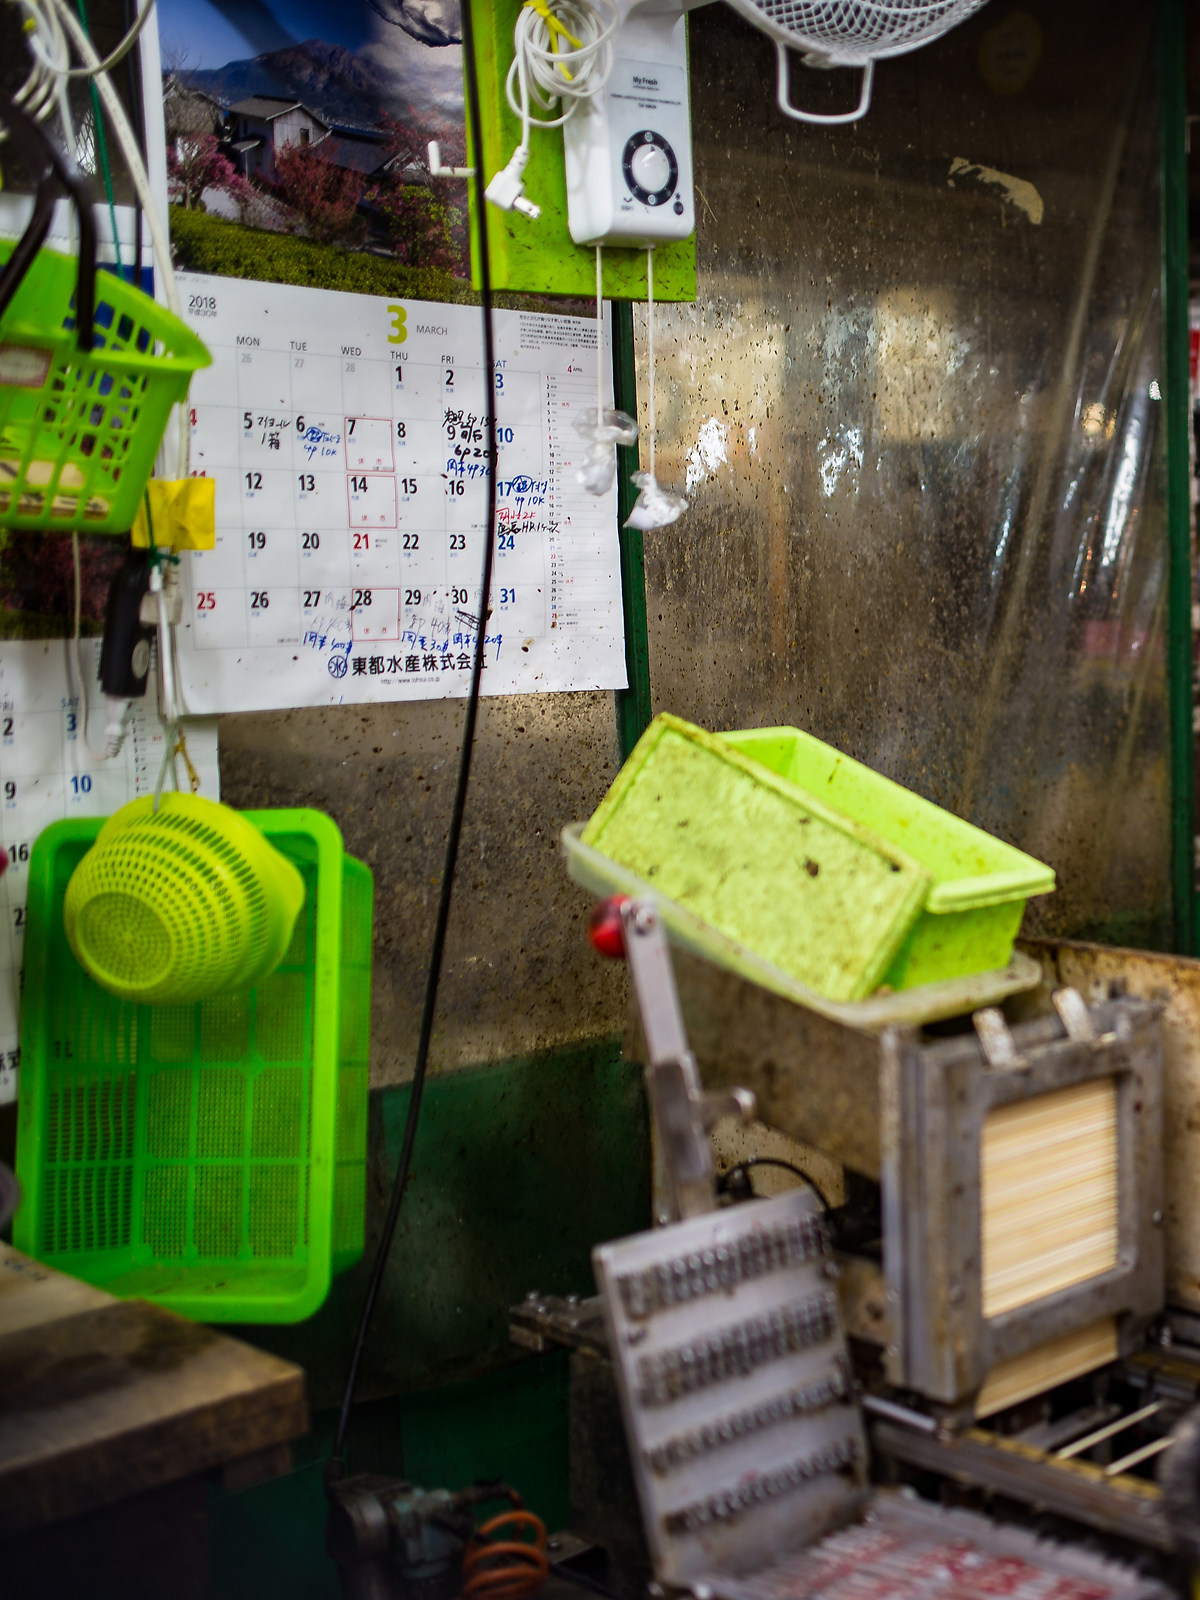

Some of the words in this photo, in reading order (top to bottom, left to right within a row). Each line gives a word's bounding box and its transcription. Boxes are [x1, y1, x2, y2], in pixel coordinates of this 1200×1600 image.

[633, 76, 642, 84] My
[642, 77, 658, 86] Fresh
[188, 294, 216, 310] 2018
[387, 304, 408, 345] 3
[416, 324, 448, 336] MARCH
[236, 336, 260, 346] MON
[290, 341, 307, 352] TUE
[341, 346, 362, 357] WED
[390, 352, 408, 362] THU
[441, 355, 454, 364] FRI
[294, 358, 304, 368] 27
[345, 362, 356, 372] 28
[395, 366, 402, 382] 1
[445, 370, 454, 386] 2
[495, 373, 504, 388] 3
[244, 412, 252, 429] 5
[296, 416, 305, 432] 6
[348, 419, 356, 436] 7
[397, 422, 406, 438] 8
[447, 426, 456, 440] 9
[496, 428, 514, 444] 10
[246, 472, 263, 490] 12
[298, 475, 316, 492] 13
[351, 476, 368, 492] 14
[402, 478, 418, 494] 15
[448, 480, 464, 496] 16
[496, 481, 512, 497] 17
[249, 532, 266, 550] 19
[302, 532, 320, 550] 20
[353, 534, 370, 550] 21
[402, 534, 420, 550] 22
[450, 534, 466, 550] 23
[498, 534, 515, 550] 24
[196, 592, 216, 610] 25
[250, 592, 270, 609] 26
[304, 590, 321, 608] 27
[354, 590, 372, 606] 28
[404, 590, 422, 606] 29
[452, 588, 468, 604] 30
[500, 588, 516, 604] 31
[3, 718, 14, 736] 2
[66, 714, 77, 732] 3
[5, 782, 16, 800] 9
[70, 774, 92, 794] 10
[8, 843, 28, 863] 16
[14, 908, 27, 927] 2
